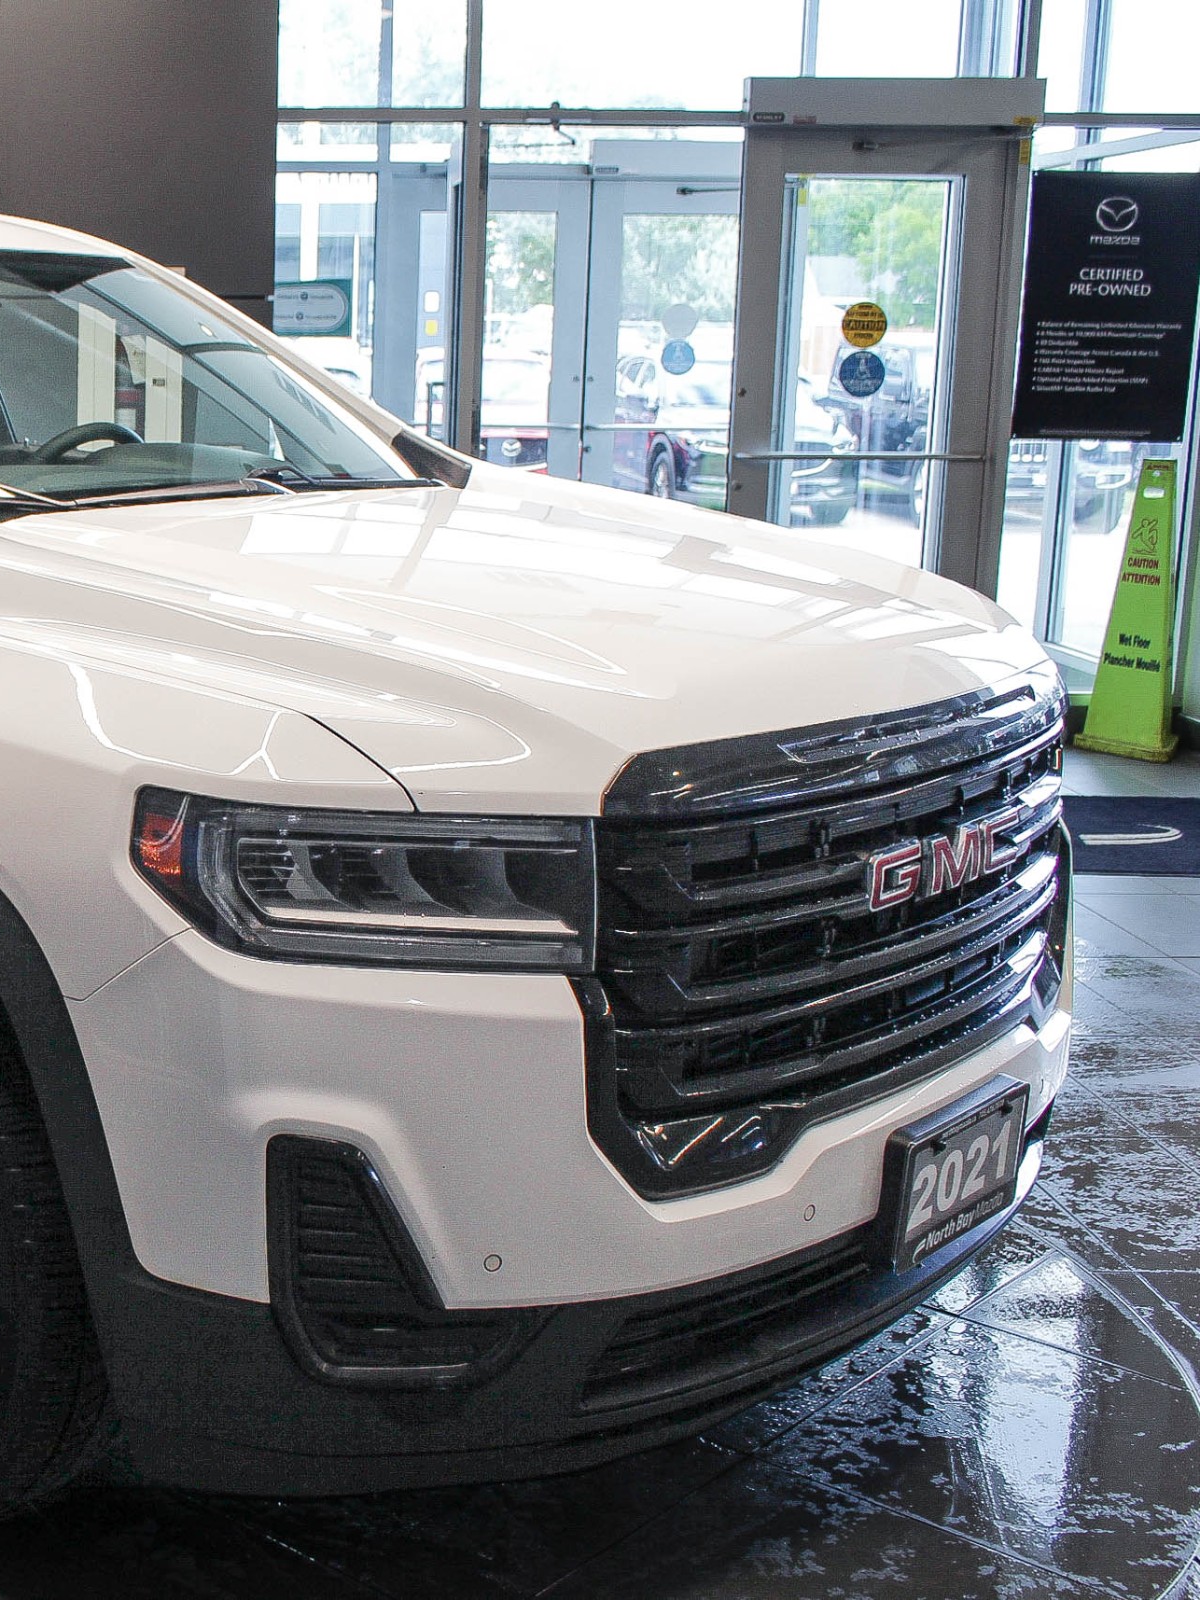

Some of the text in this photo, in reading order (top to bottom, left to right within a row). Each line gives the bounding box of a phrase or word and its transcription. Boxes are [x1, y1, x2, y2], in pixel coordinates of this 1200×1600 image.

[1090, 234, 1140, 246] mazda
[1080, 268, 1144, 281] CERTIFIED
[1069, 283, 1152, 297] PRE-OWNED
[1127, 557, 1159, 570] CAUTION
[1121, 572, 1161, 586] ATTENTION
[1119, 633, 1151, 649] Wet Floor
[1103, 652, 1135, 668] Plancher
[869, 811, 1020, 913] GMC
[905, 1119, 1012, 1234] 2021
[925, 1218, 956, 1251] North
[956, 1208, 976, 1232] Bay
